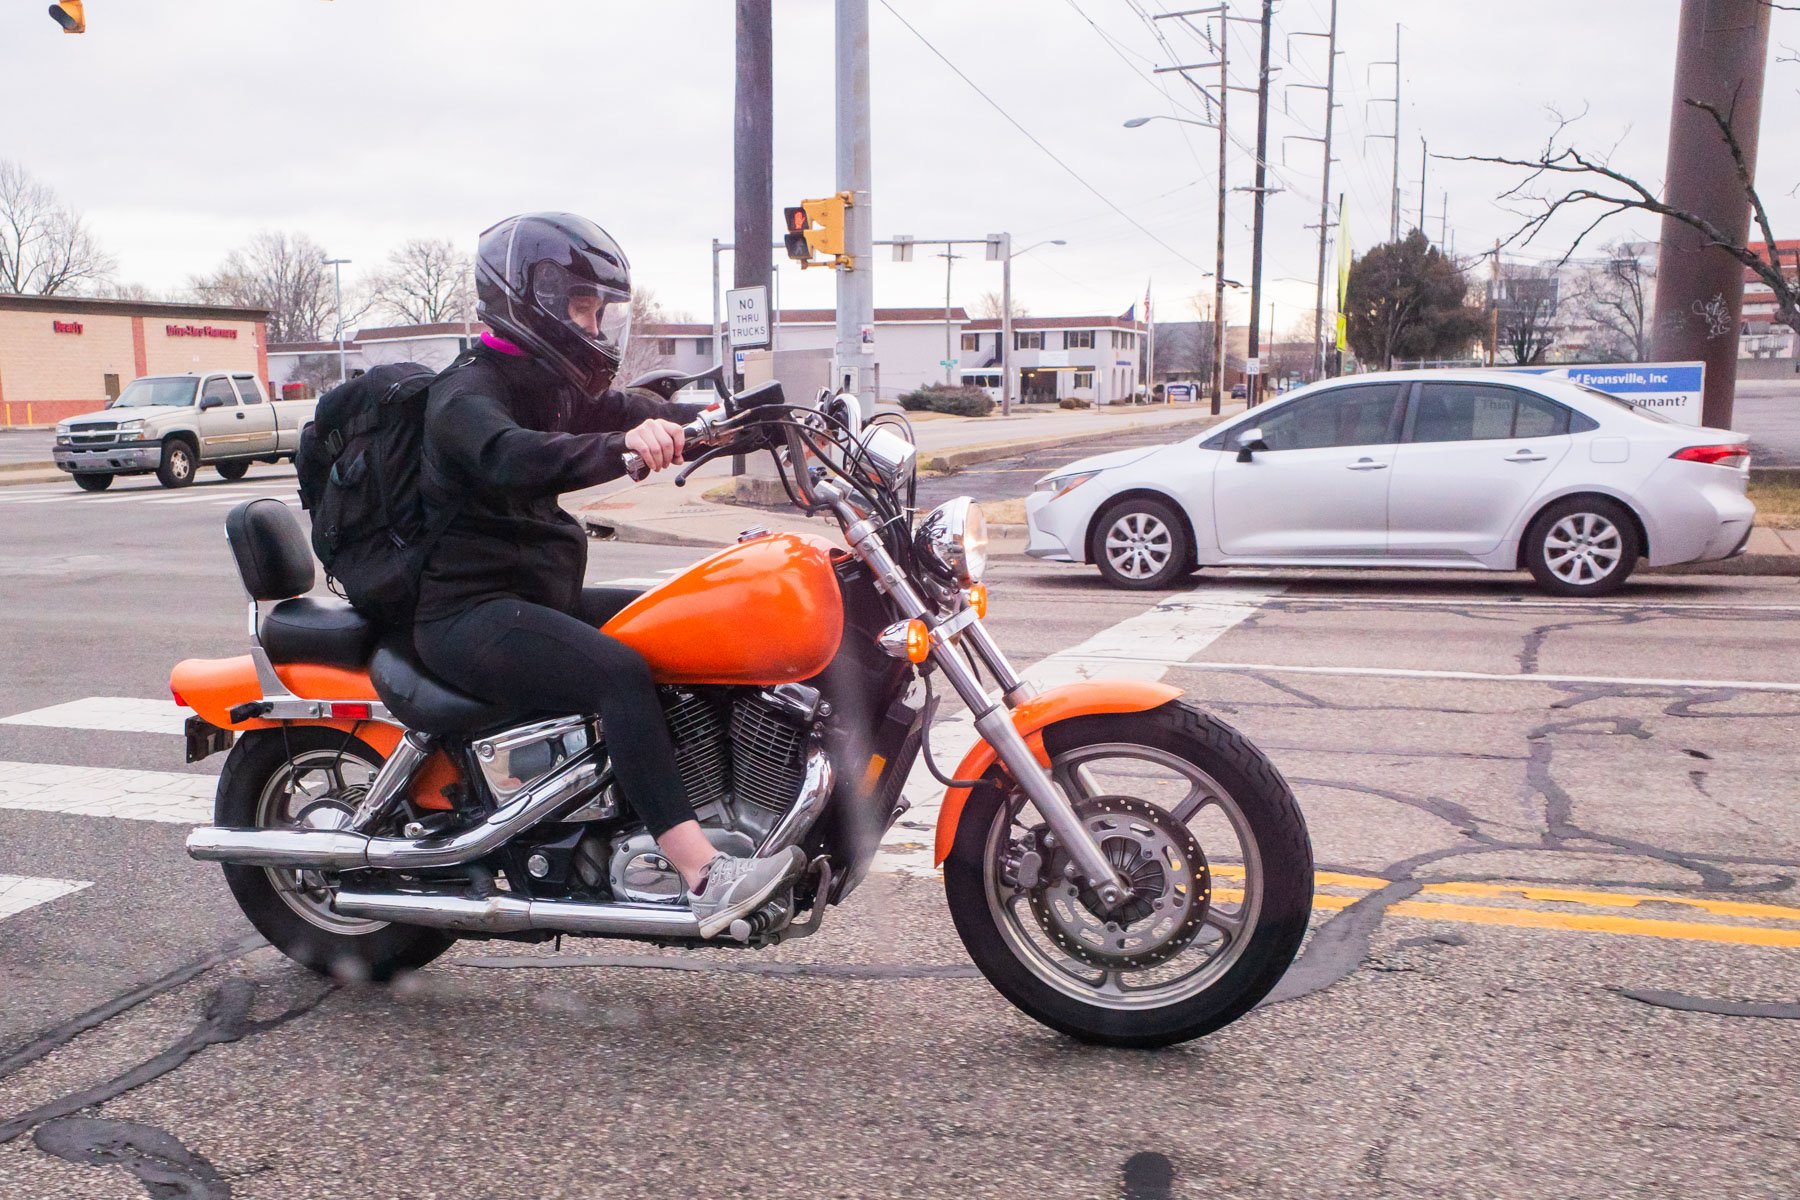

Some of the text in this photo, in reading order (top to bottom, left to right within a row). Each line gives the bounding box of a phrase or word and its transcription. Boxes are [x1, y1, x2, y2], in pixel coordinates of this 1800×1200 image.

[739, 298, 754, 310] NO
[736, 313, 759, 324] THRU
[732, 326, 766, 337] TRUCKS
[1569, 373, 1668, 385] of Evansville, Inc
[1630, 396, 1687, 408] egnant?
